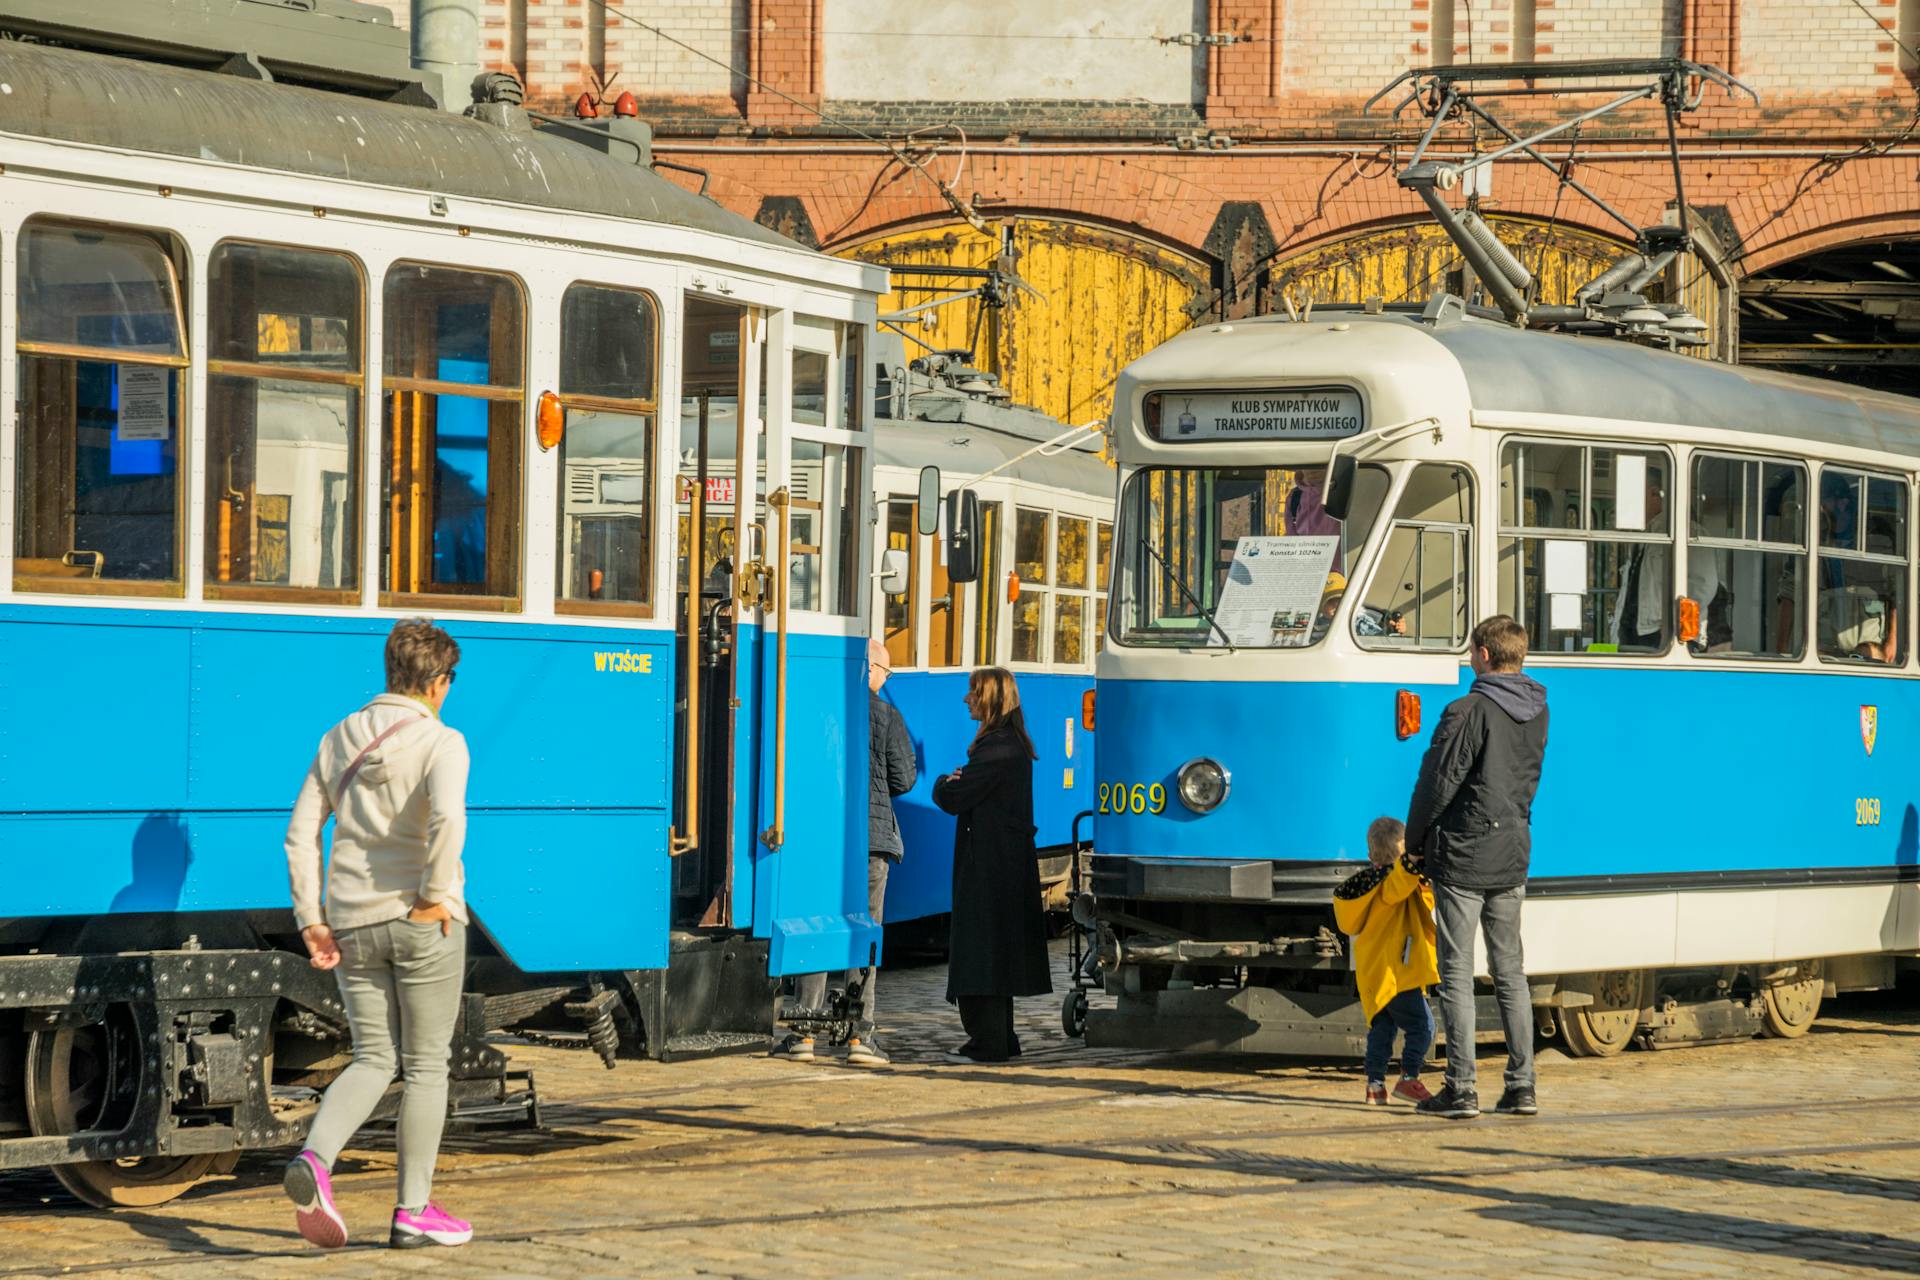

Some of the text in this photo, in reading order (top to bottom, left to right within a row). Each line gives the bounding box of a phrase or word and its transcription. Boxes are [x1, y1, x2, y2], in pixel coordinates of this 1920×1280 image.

[1231, 397, 1340, 414] KLUB SYMPATYKÓW
[1214, 416, 1357, 431] TRANSPORTU MIEJSKIEGO
[593, 648, 653, 673] WYJŚCIE
[1098, 782, 1167, 815] 2069
[1855, 798, 1881, 826] 2069
